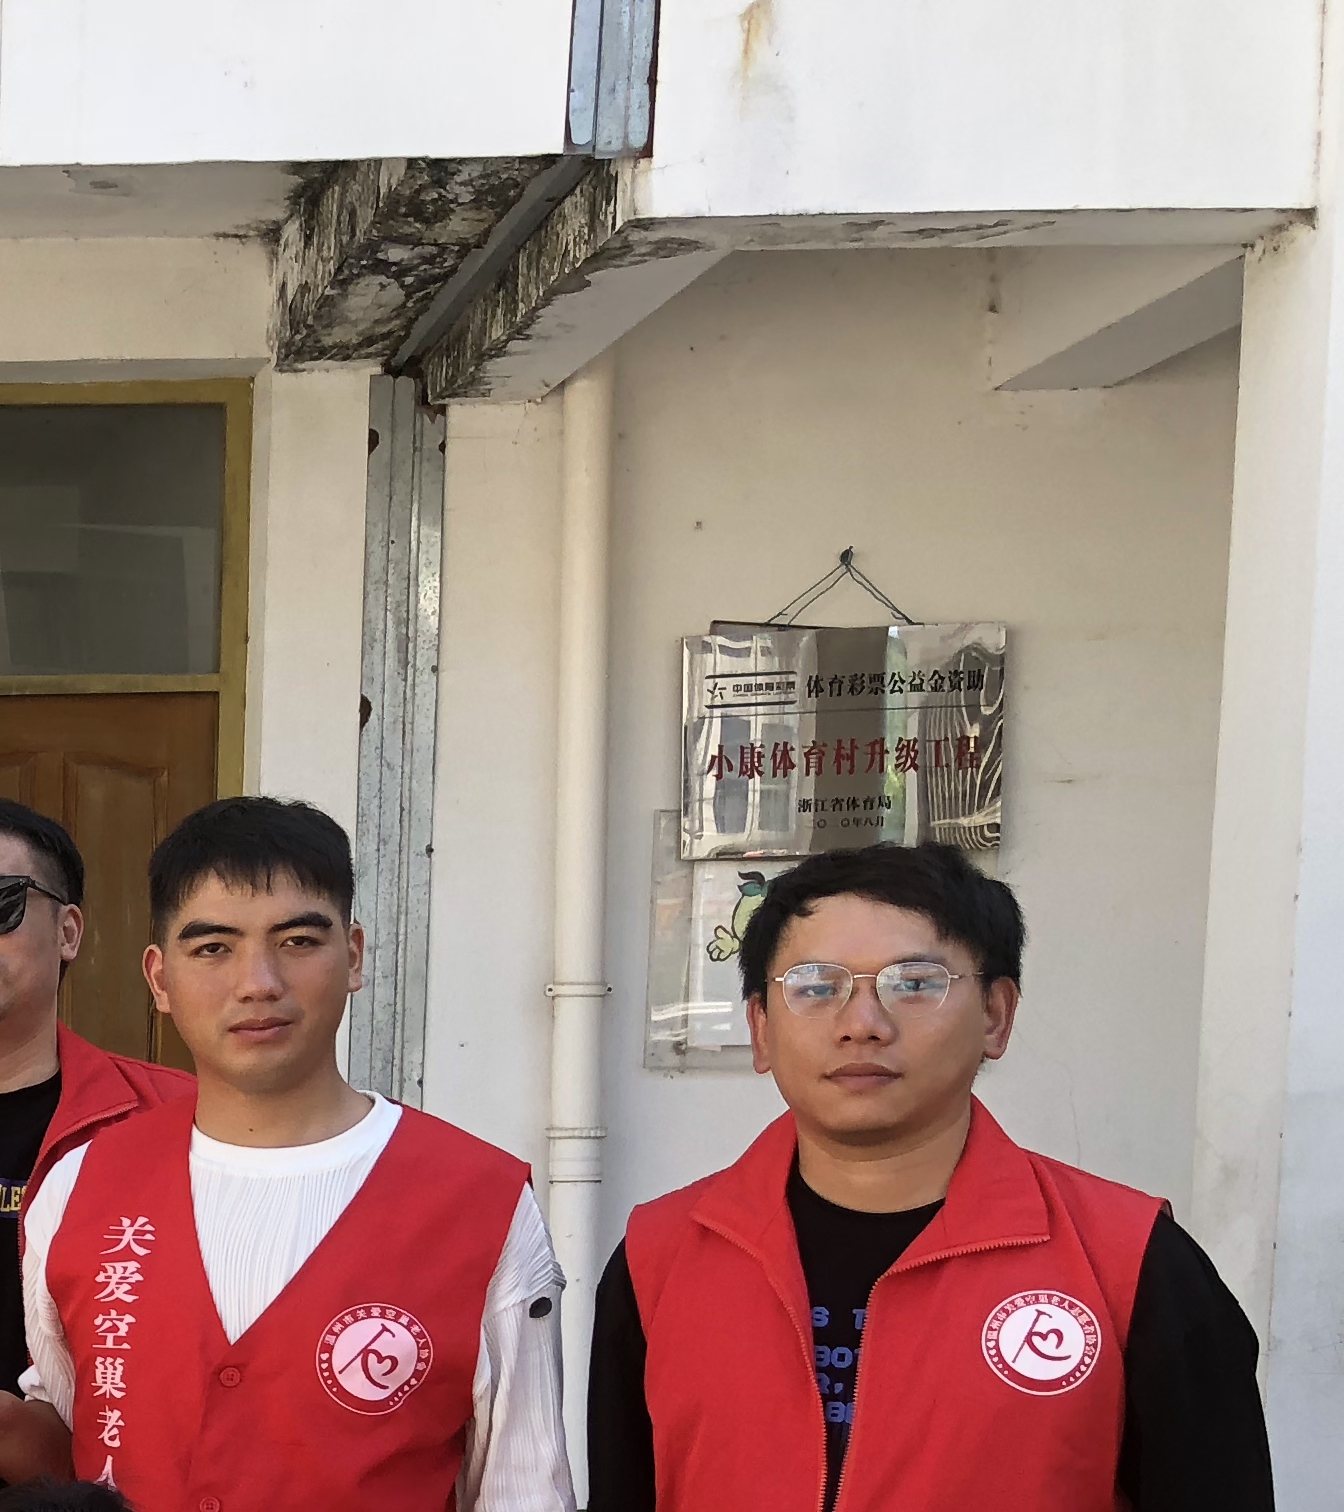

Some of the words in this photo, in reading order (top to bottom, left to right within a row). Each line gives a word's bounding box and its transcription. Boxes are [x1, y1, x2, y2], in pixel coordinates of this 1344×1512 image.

[806, 668, 985, 699] 体育彩票公益金资助
[706, 736, 983, 782] 小康体育村升级工程
[797, 796, 892, 813] 浙江省体育局
